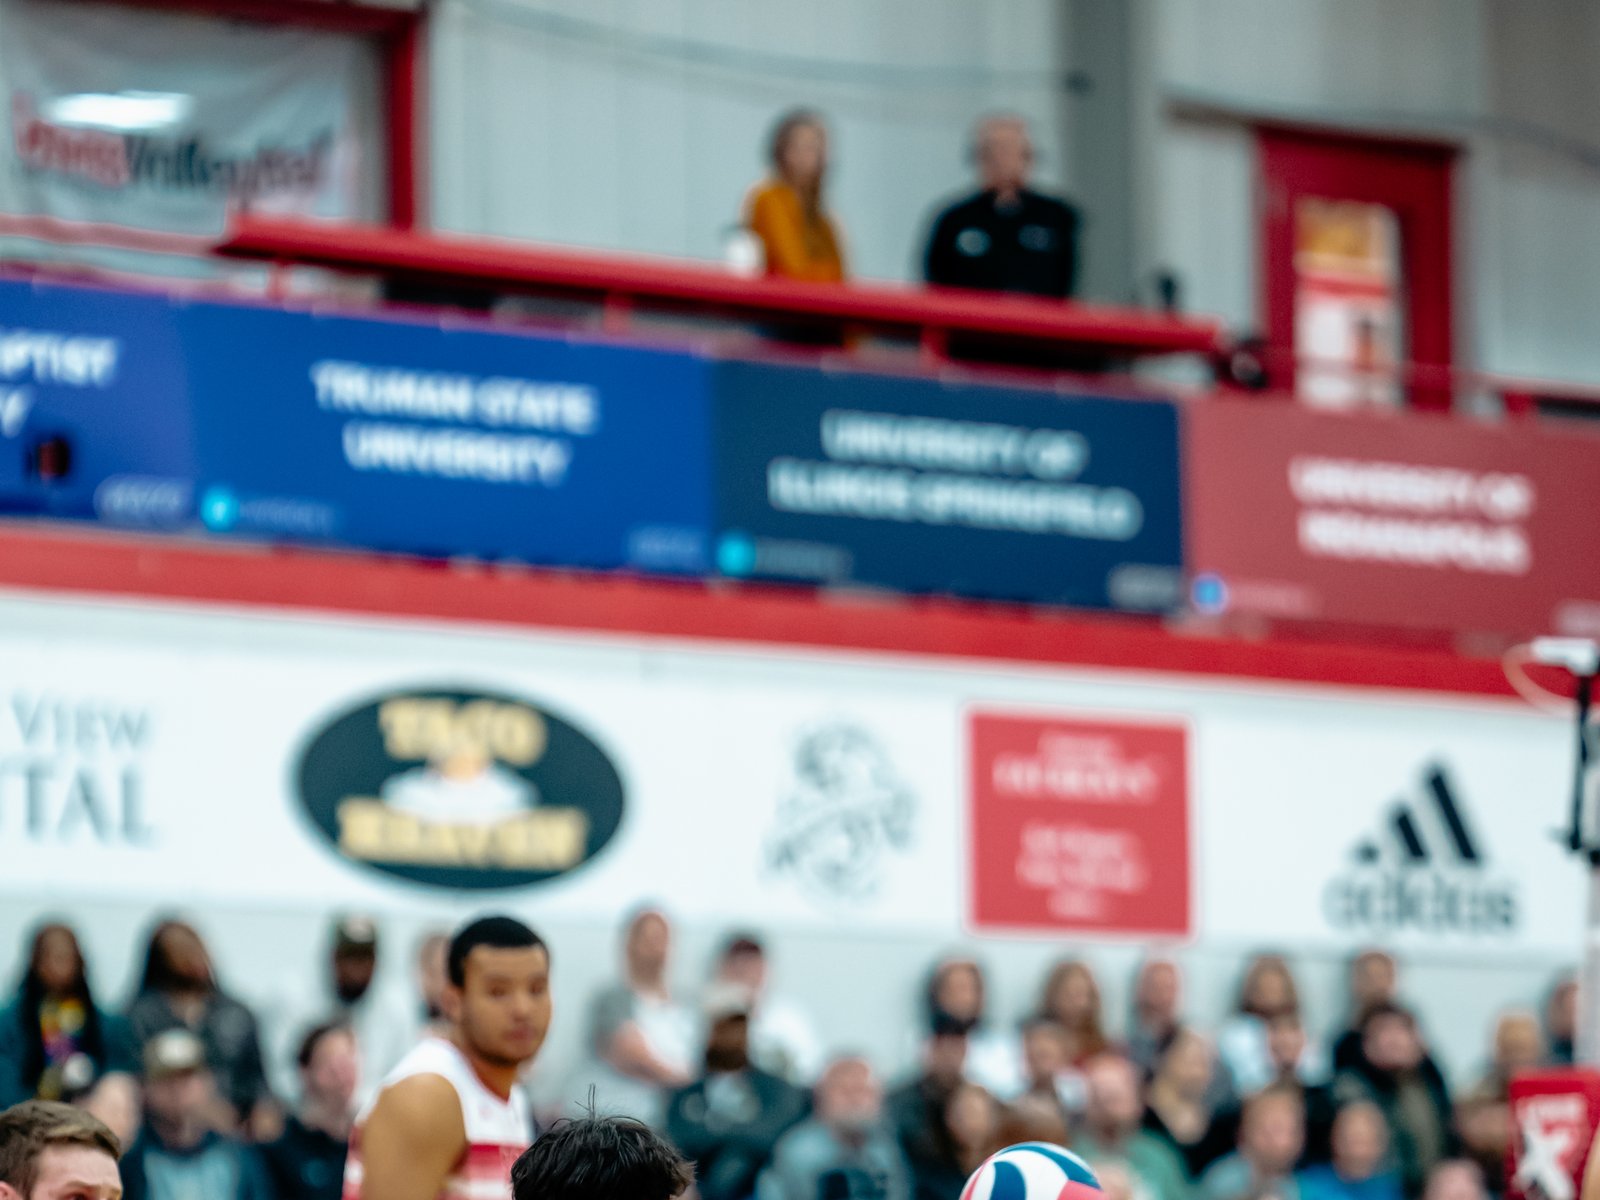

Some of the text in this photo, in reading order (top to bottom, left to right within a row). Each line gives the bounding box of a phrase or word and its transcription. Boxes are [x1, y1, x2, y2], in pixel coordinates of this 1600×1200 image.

[0, 333, 116, 387] PTIST
[309, 361, 598, 436] TRUMAN STATE
[343, 420, 572, 486] UNIVERSITY
[11, 688, 153, 750] VIEW
[380, 698, 545, 767] TACO
[0, 760, 160, 845] TAL
[1323, 872, 1517, 932] adidas
